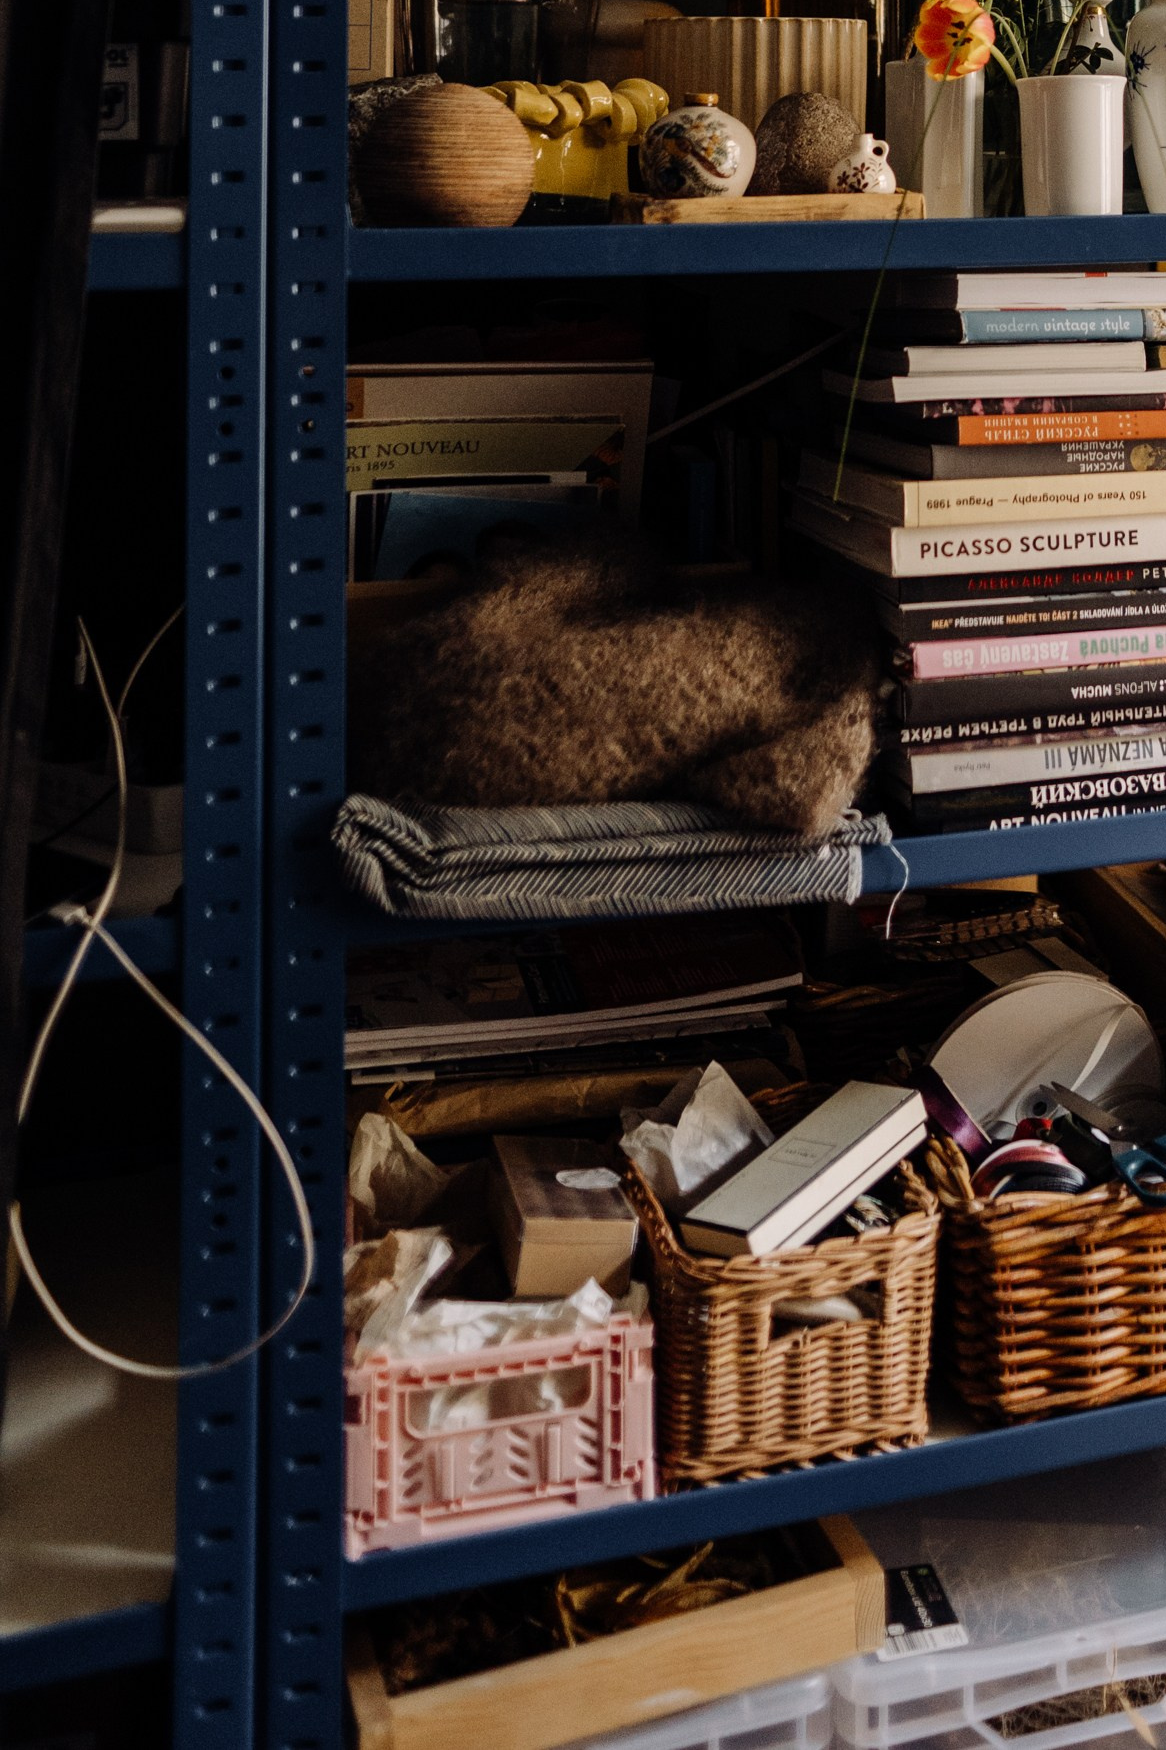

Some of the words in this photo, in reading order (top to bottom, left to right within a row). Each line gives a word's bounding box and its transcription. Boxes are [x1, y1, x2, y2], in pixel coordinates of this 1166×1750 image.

[985, 318, 1040, 334] modern
[1042, 316, 1097, 337] vintage
[1099, 315, 1131, 334] style
[984, 429, 1030, 441] СТИЛЬ
[1036, 426, 1099, 441] РУССКИЙ
[346, 445, 370, 459] RT
[376, 440, 480, 458] NOUVEAU
[1061, 440, 1125, 452] УКРАШЕНИЯ
[1066, 451, 1125, 462] НАРОДНЫЕ
[367, 461, 395, 471] 1895
[1079, 461, 1125, 472] РУССКИЕ
[926, 498, 951, 509] 1989
[956, 495, 994, 509] Prague
[1011, 491, 1080, 506] Photography
[1084, 492, 1097, 503] of
[1100, 491, 1126, 502] Years
[1129, 490, 1147, 501] 150
[919, 536, 1013, 560] PICASSO
[1019, 529, 1139, 554] SCULPTURE
[954, 615, 1004, 629] PŘEDSTAVUJE
[1005, 612, 1037, 625] NAJDĚTE
[1038, 611, 1051, 623] TO!
[1052, 609, 1071, 621] ČÁST
[1072, 610, 1078, 620] 2
[1079, 605, 1124, 619] SKLADOVÁNÍ
[1125, 604, 1144, 616] JÍDLA
[1144, 604, 1151, 615] A
[980, 640, 1069, 667] Zastavený
[1078, 634, 1150, 658] Puchová
[942, 650, 975, 671] čas
[1070, 683, 1113, 699] MUCHA
[1114, 679, 1157, 695] ALFONS
[958, 717, 1028, 737] ТРЕТЬЕМ
[1033, 716, 1041, 728] В
[1046, 713, 1085, 730] ТРУД
[900, 725, 953, 744] РЕЙХЕ
[1044, 746, 1063, 769] III
[1065, 737, 1154, 768] NEZNÁMÁ
